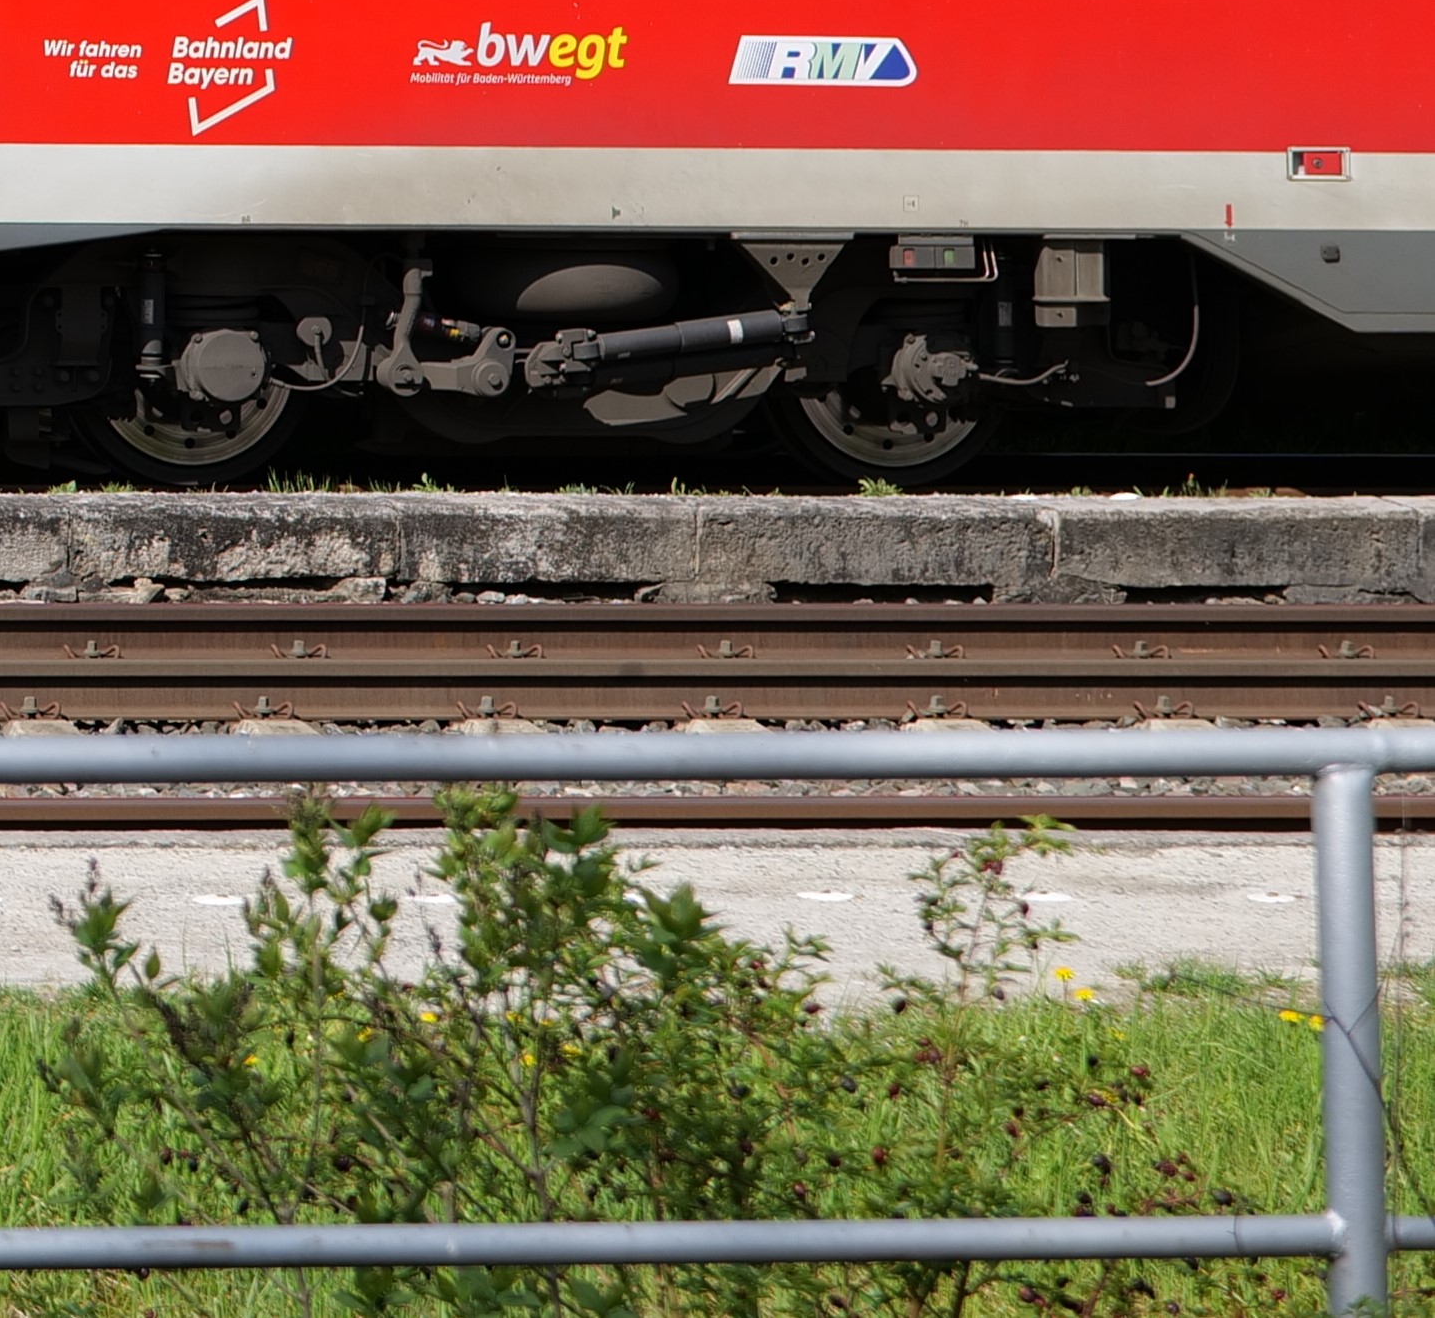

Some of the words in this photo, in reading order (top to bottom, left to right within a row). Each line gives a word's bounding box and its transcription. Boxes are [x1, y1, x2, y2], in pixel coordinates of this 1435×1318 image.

[43, 39, 75, 57] Wir
[78, 40, 142, 58] fahren
[171, 36, 294, 60] Bahnland
[476, 21, 628, 80] bwegt
[69, 60, 97, 78] für
[100, 61, 138, 79] das
[766, 40, 895, 81] RMV
[166, 62, 255, 90] Bayern
[410, 72, 455, 84] Mobilität
[456, 72, 471, 86] für
[472, 73, 572, 86] Baden-Württemberg
